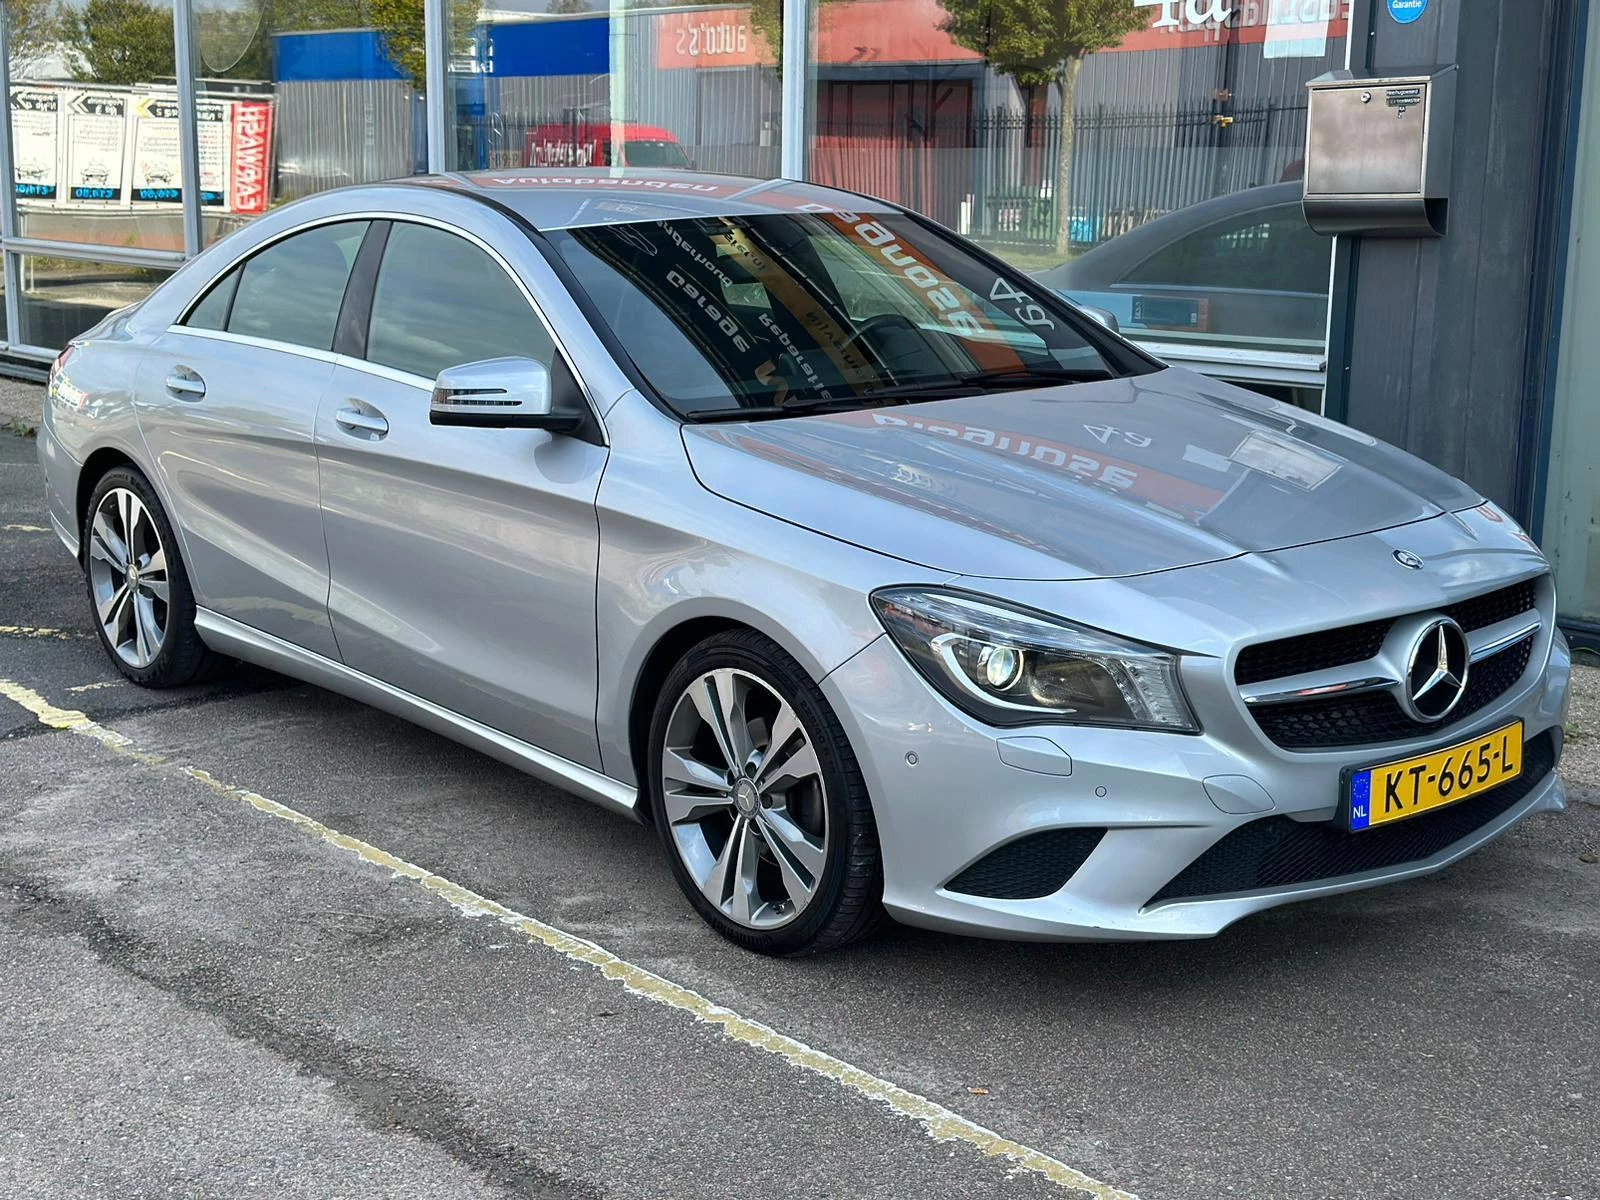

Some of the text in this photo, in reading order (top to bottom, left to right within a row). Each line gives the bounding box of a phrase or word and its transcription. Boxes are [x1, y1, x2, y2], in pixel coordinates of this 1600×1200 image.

[1392, 0, 1422, 9] Garantie
[1385, 736, 1513, 813] KT-665-L
[1353, 805, 1367, 819] NL
